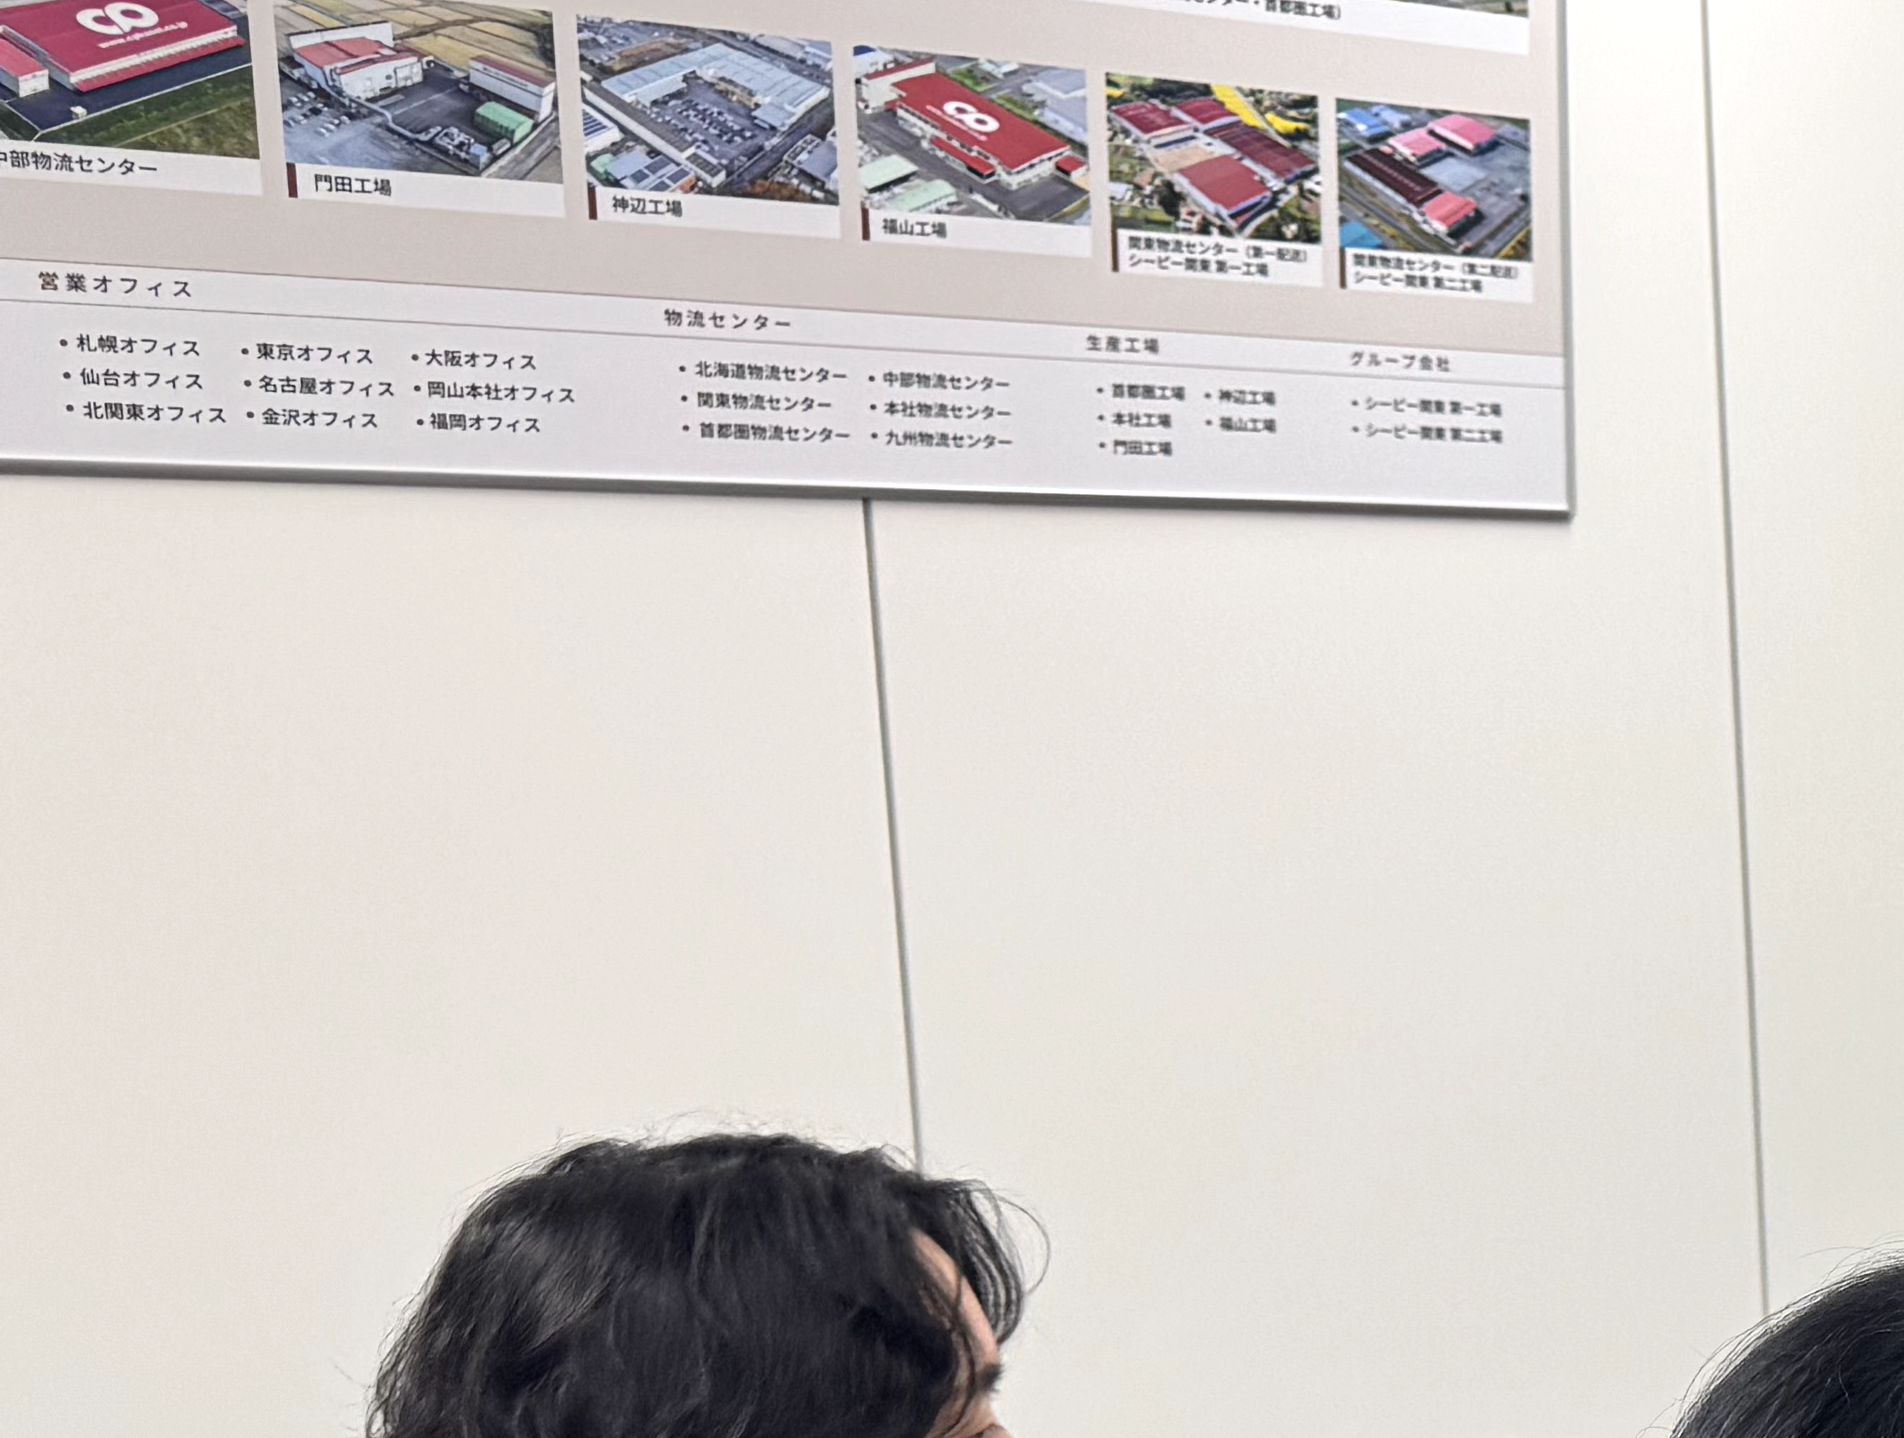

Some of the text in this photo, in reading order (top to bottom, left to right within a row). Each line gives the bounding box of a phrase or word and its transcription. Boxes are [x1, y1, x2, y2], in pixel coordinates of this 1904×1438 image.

[314, 173, 392, 197] 門田工場
[611, 195, 683, 218] 神辺工場
[882, 218, 947, 239] 福山工場
[38, 272, 192, 297] 営業オフィス
[664, 309, 791, 330] 物流センター
[76, 333, 200, 357] 札幌オフィス
[256, 342, 373, 364] 東京オフィス
[1086, 335, 1159, 354] 生産工場
[425, 349, 536, 370] 大阪オフィス
[1350, 351, 1450, 372] グループ会社
[80, 367, 203, 389] 仙台オフィス
[695, 360, 847, 383] 北海道物流センター
[259, 375, 394, 398] 名古屋オフィス
[427, 381, 575, 404] 岡山本社オフィス
[82, 401, 227, 424] 北関東オフィス
[697, 391, 832, 412] 関東物流センター
[262, 408, 378, 429] 金沢オフィス
[429, 412, 540, 433] 福岡オフィス
